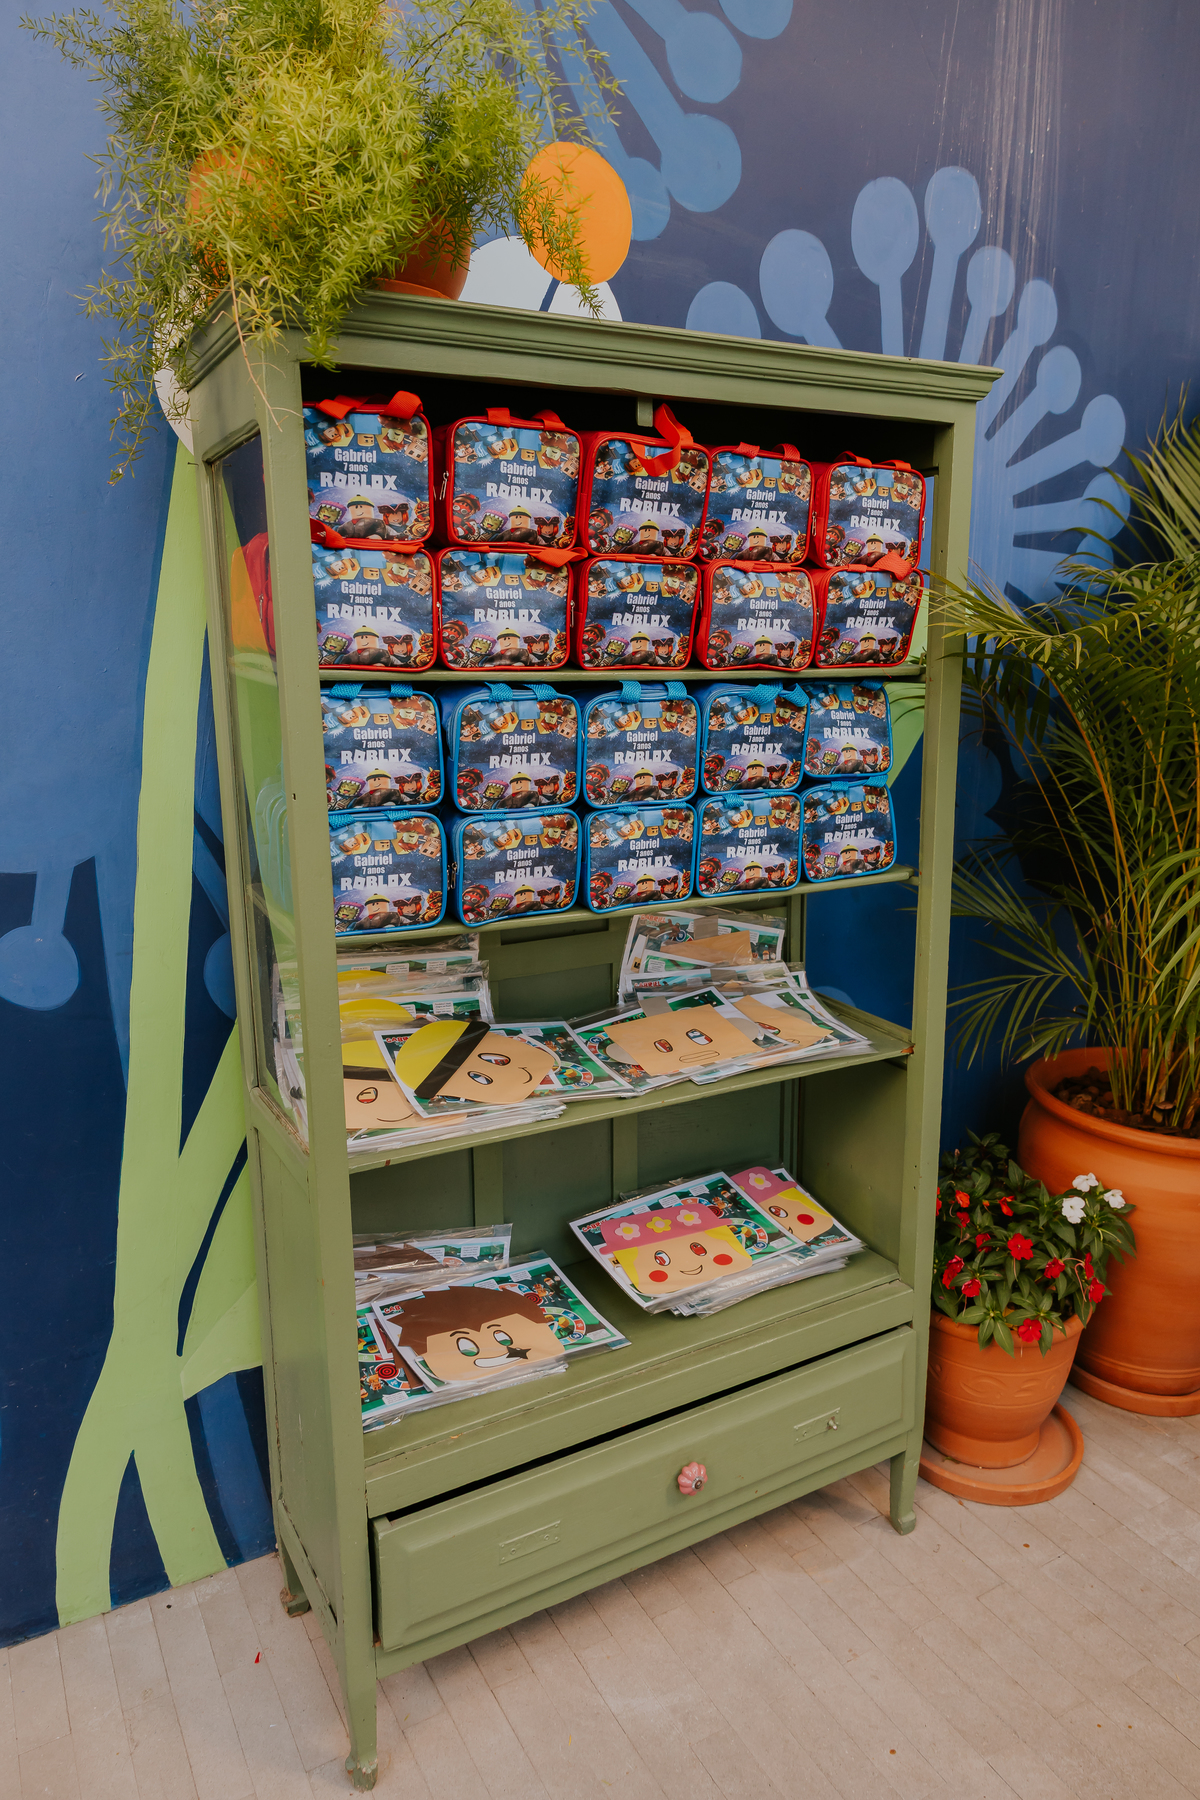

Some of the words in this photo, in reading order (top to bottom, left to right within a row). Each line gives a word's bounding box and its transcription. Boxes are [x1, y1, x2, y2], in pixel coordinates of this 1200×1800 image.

[335, 448, 376, 463] Gabriel
[344, 463, 347, 471] 7
[349, 464, 368, 472] anos
[500, 461, 536, 476] Gabriel
[320, 472, 397, 490] ROBLOX
[513, 476, 528, 484] anos
[635, 478, 668, 492] Gabriel
[486, 483, 553, 503] ROBLOX
[746, 489, 775, 501] Gabriel
[620, 498, 681, 517] ROBLOX
[862, 497, 889, 509] Gabriel
[731, 508, 787, 523] ROBLOX
[850, 515, 900, 531] ROBLOX
[341, 581, 381, 595] Gabriel
[486, 588, 522, 600] Gabriel
[355, 596, 373, 604] anos
[499, 600, 516, 608] anos
[627, 593, 658, 605] Gabriel
[750, 599, 778, 610] Gabriel
[859, 599, 886, 609] Gabriel
[327, 603, 402, 622] ROBLOX
[474, 608, 541, 623] ROBLOX
[612, 613, 670, 627] ROBLOX
[737, 618, 790, 631] ROBLOX
[846, 616, 895, 628] ROBLOX
[831, 711, 855, 720] Gabriel
[354, 728, 392, 740] Gabriel
[744, 725, 770, 735] Gabriel
[824, 727, 870, 739] ROBLOX
[502, 733, 535, 745] Gabriel
[627, 731, 658, 742] Gabriel
[367, 740, 385, 748] anos
[731, 743, 783, 755] ROBLOX
[341, 748, 411, 764] ROBLOX
[489, 752, 551, 769] ROBLOX
[615, 749, 672, 764] ROBLOX
[836, 813, 862, 824] Gabriel
[739, 827, 767, 838] Gabriel
[824, 828, 874, 843] ROBLOX
[630, 838, 659, 850] Gabriel
[506, 849, 539, 861] Gabriel
[727, 843, 779, 858] ROBLOX
[354, 854, 392, 867] Gabriel
[618, 855, 672, 872] ROBLOX
[367, 866, 385, 874] anos
[495, 865, 553, 884] ROBLOX
[341, 873, 411, 891] ROBLOX
